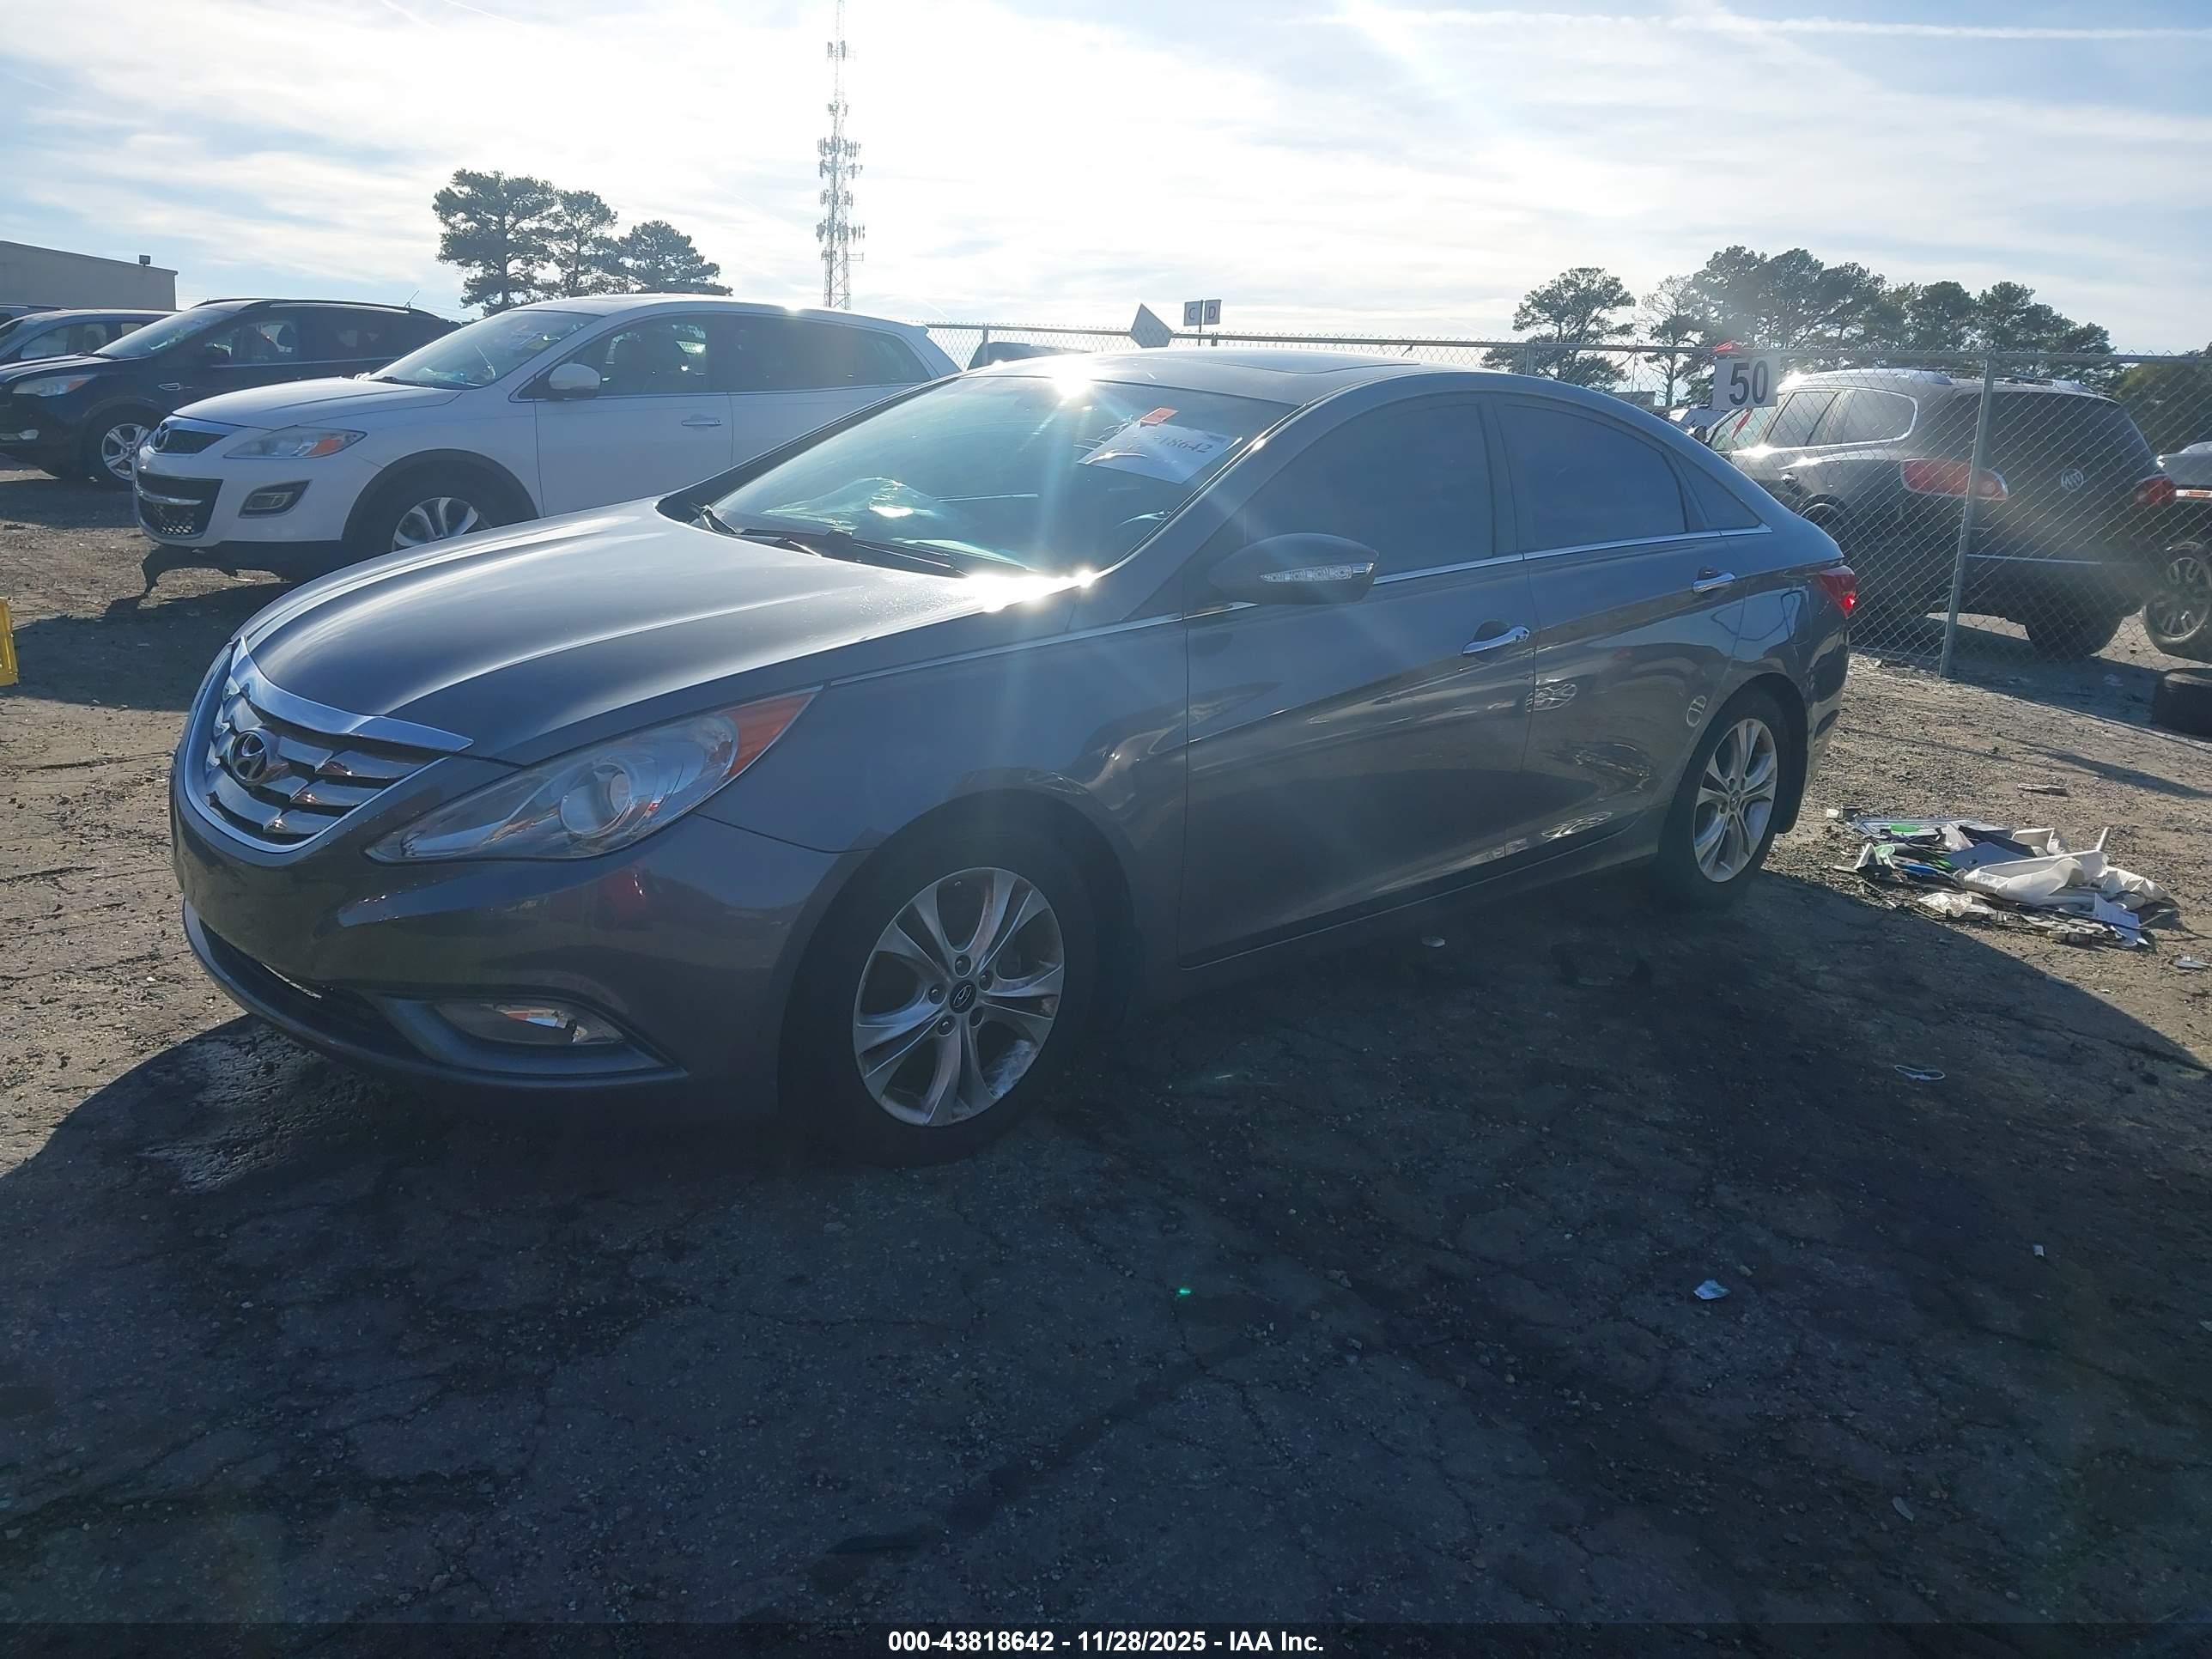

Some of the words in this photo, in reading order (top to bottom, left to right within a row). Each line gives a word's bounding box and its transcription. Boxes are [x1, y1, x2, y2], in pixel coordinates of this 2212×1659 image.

[1188, 307, 1196, 320] C
[1208, 306, 1217, 319] D
[1729, 361, 1768, 405] 50
